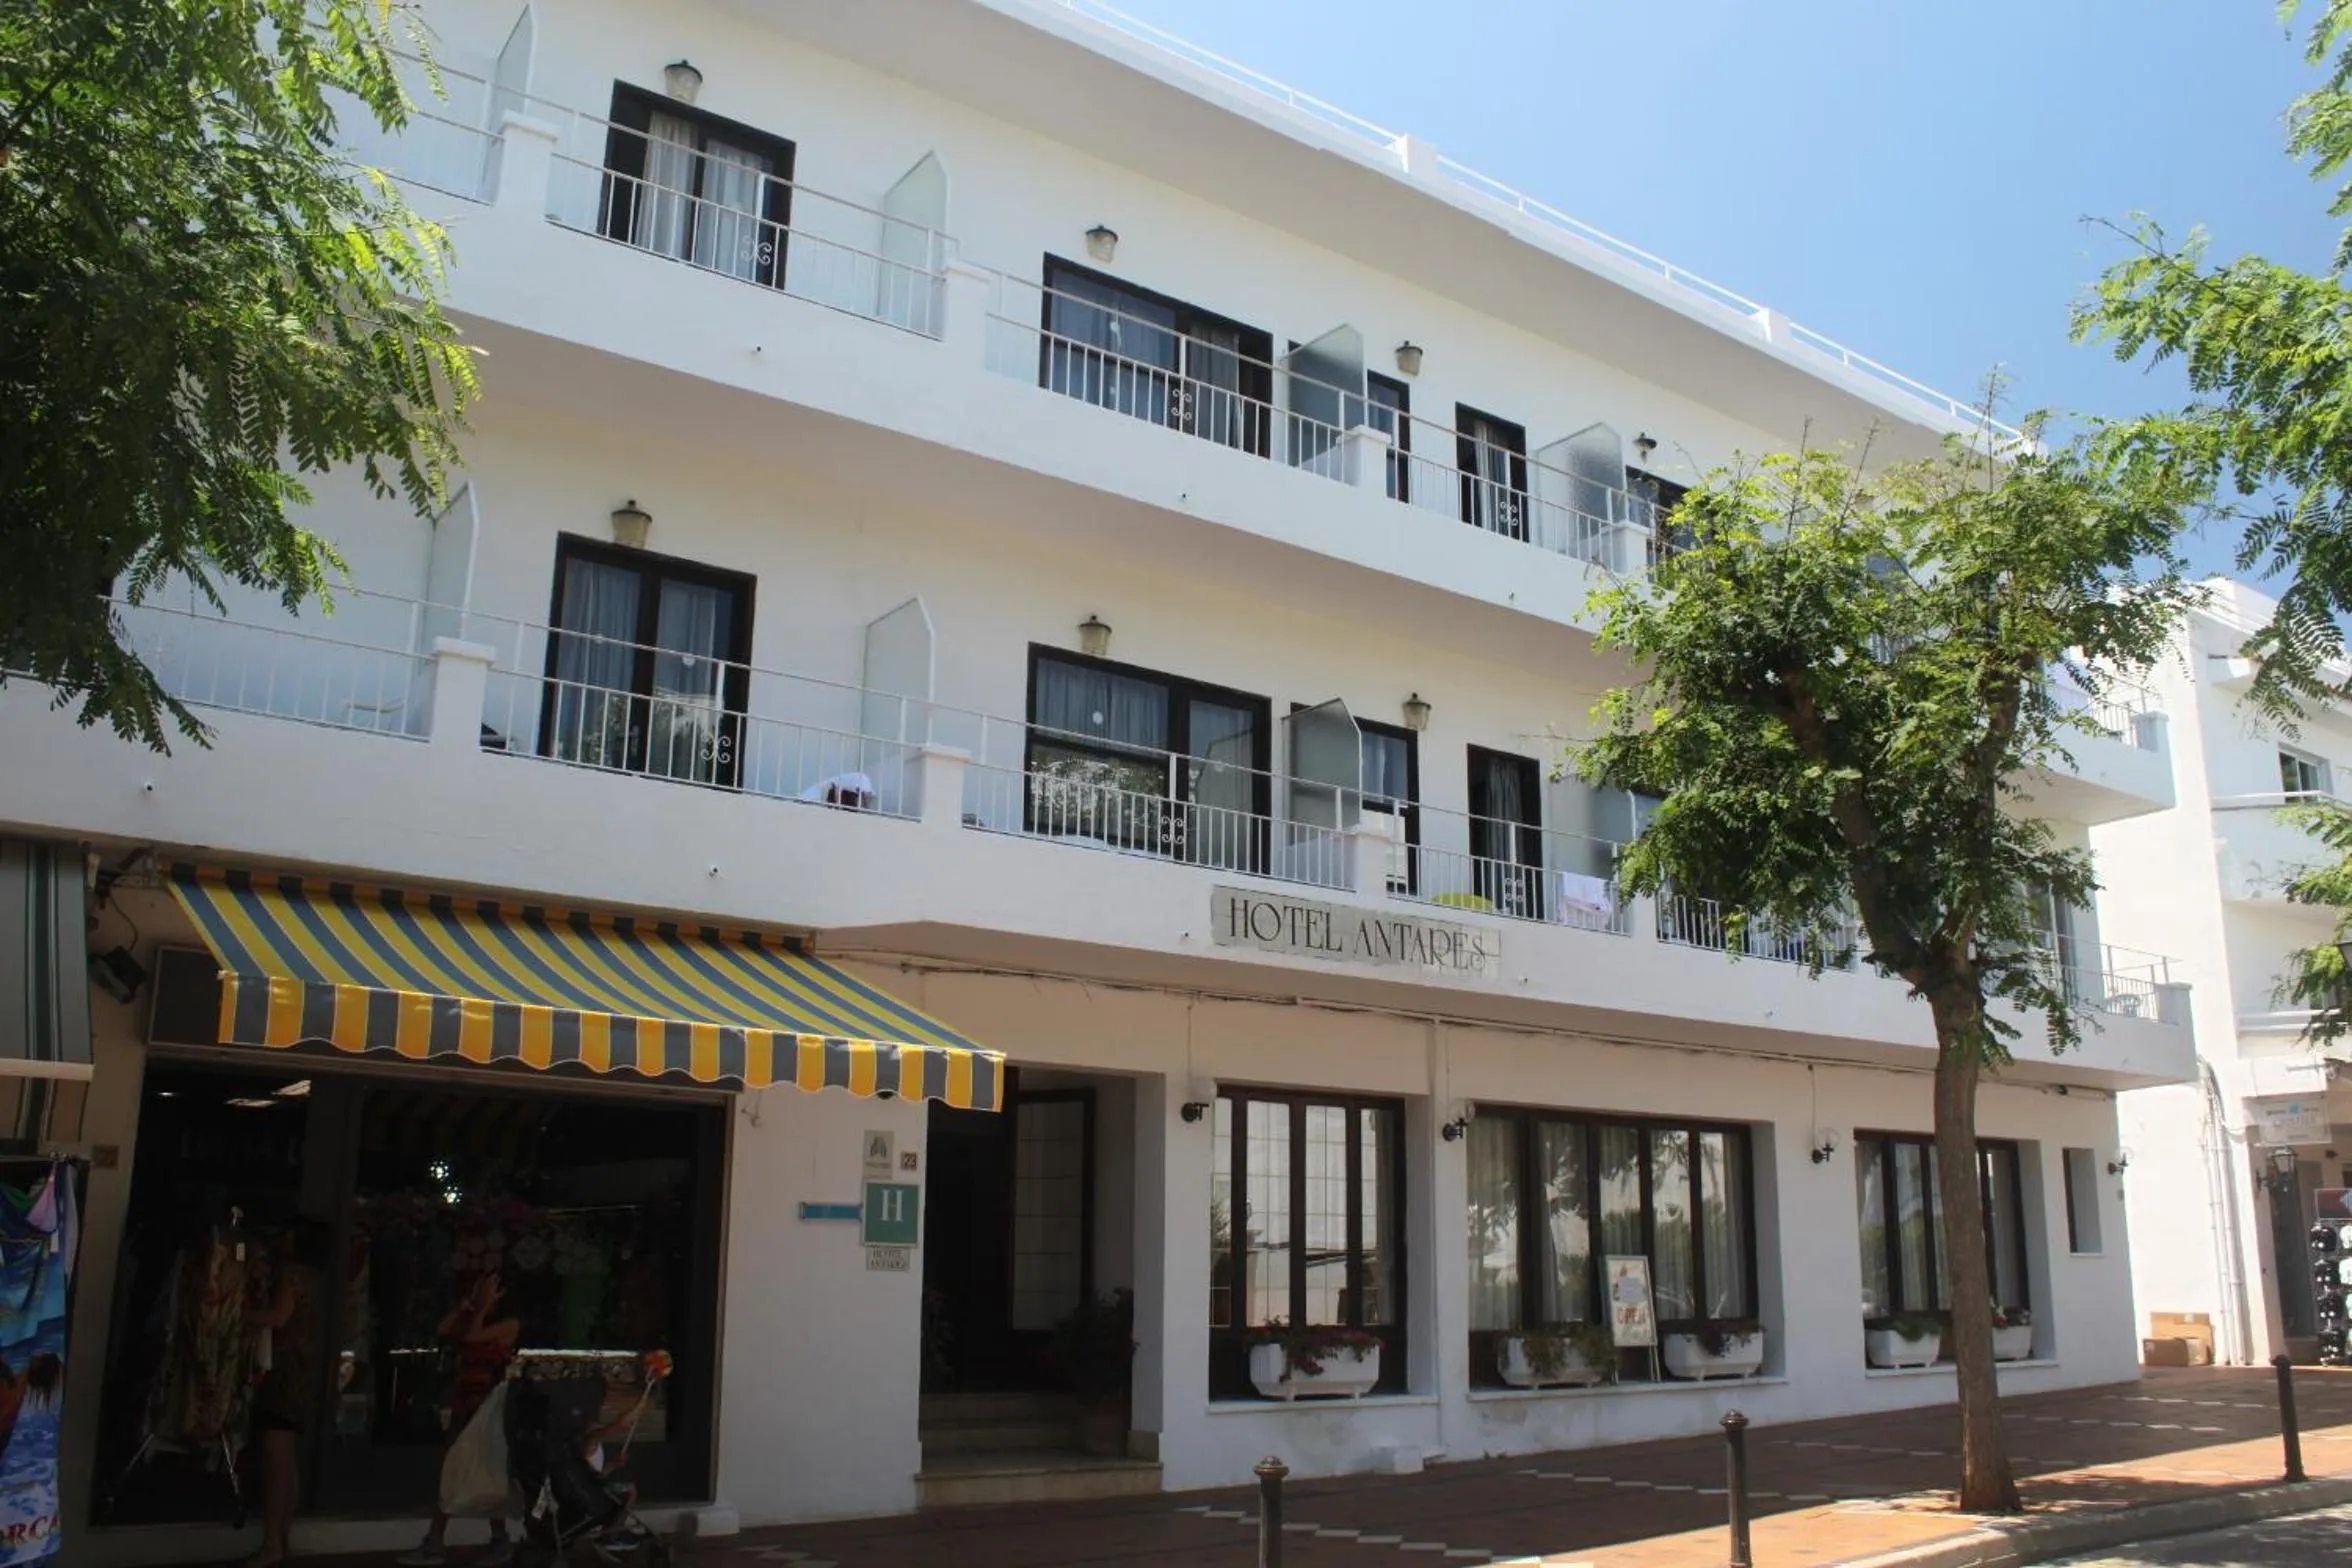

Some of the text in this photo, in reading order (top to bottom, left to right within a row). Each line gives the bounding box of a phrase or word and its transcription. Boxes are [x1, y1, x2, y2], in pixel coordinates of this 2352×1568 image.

[1230, 897, 1486, 971] HOTEL ANTARES
[879, 1189, 905, 1222] H
